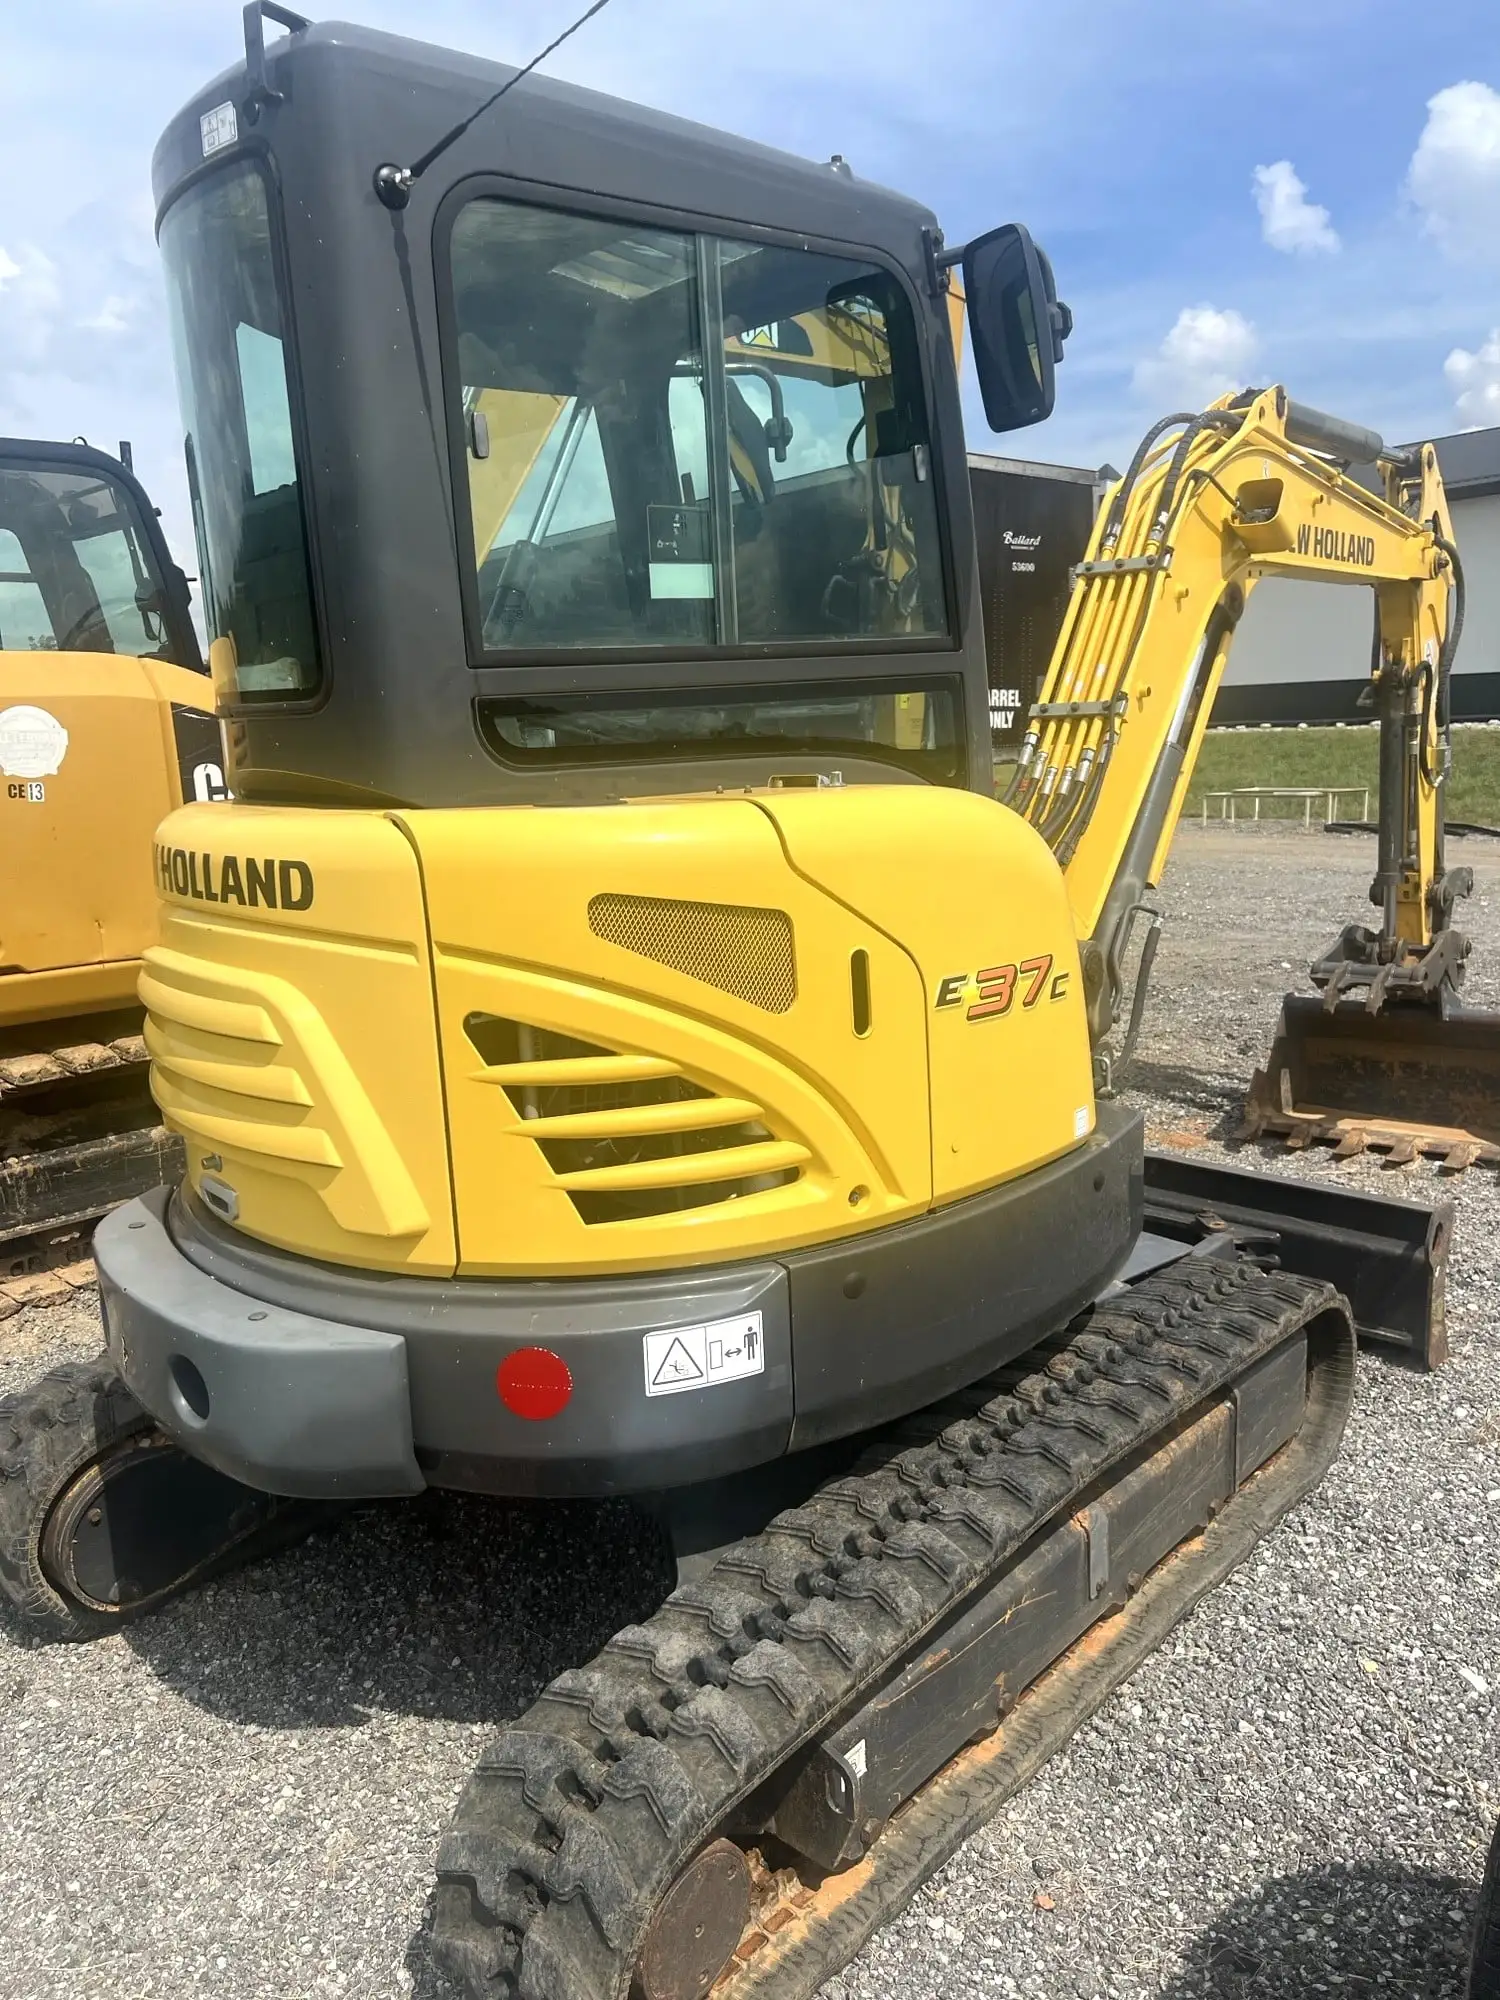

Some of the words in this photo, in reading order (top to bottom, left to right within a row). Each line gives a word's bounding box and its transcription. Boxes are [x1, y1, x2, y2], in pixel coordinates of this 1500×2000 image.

[1003, 531, 1041, 546] Ballard
[1313, 526, 1375, 567] HOLLAND
[8, 783, 25, 799] CE
[28, 783, 43, 801] 13
[160, 844, 314, 912] HOLLAND
